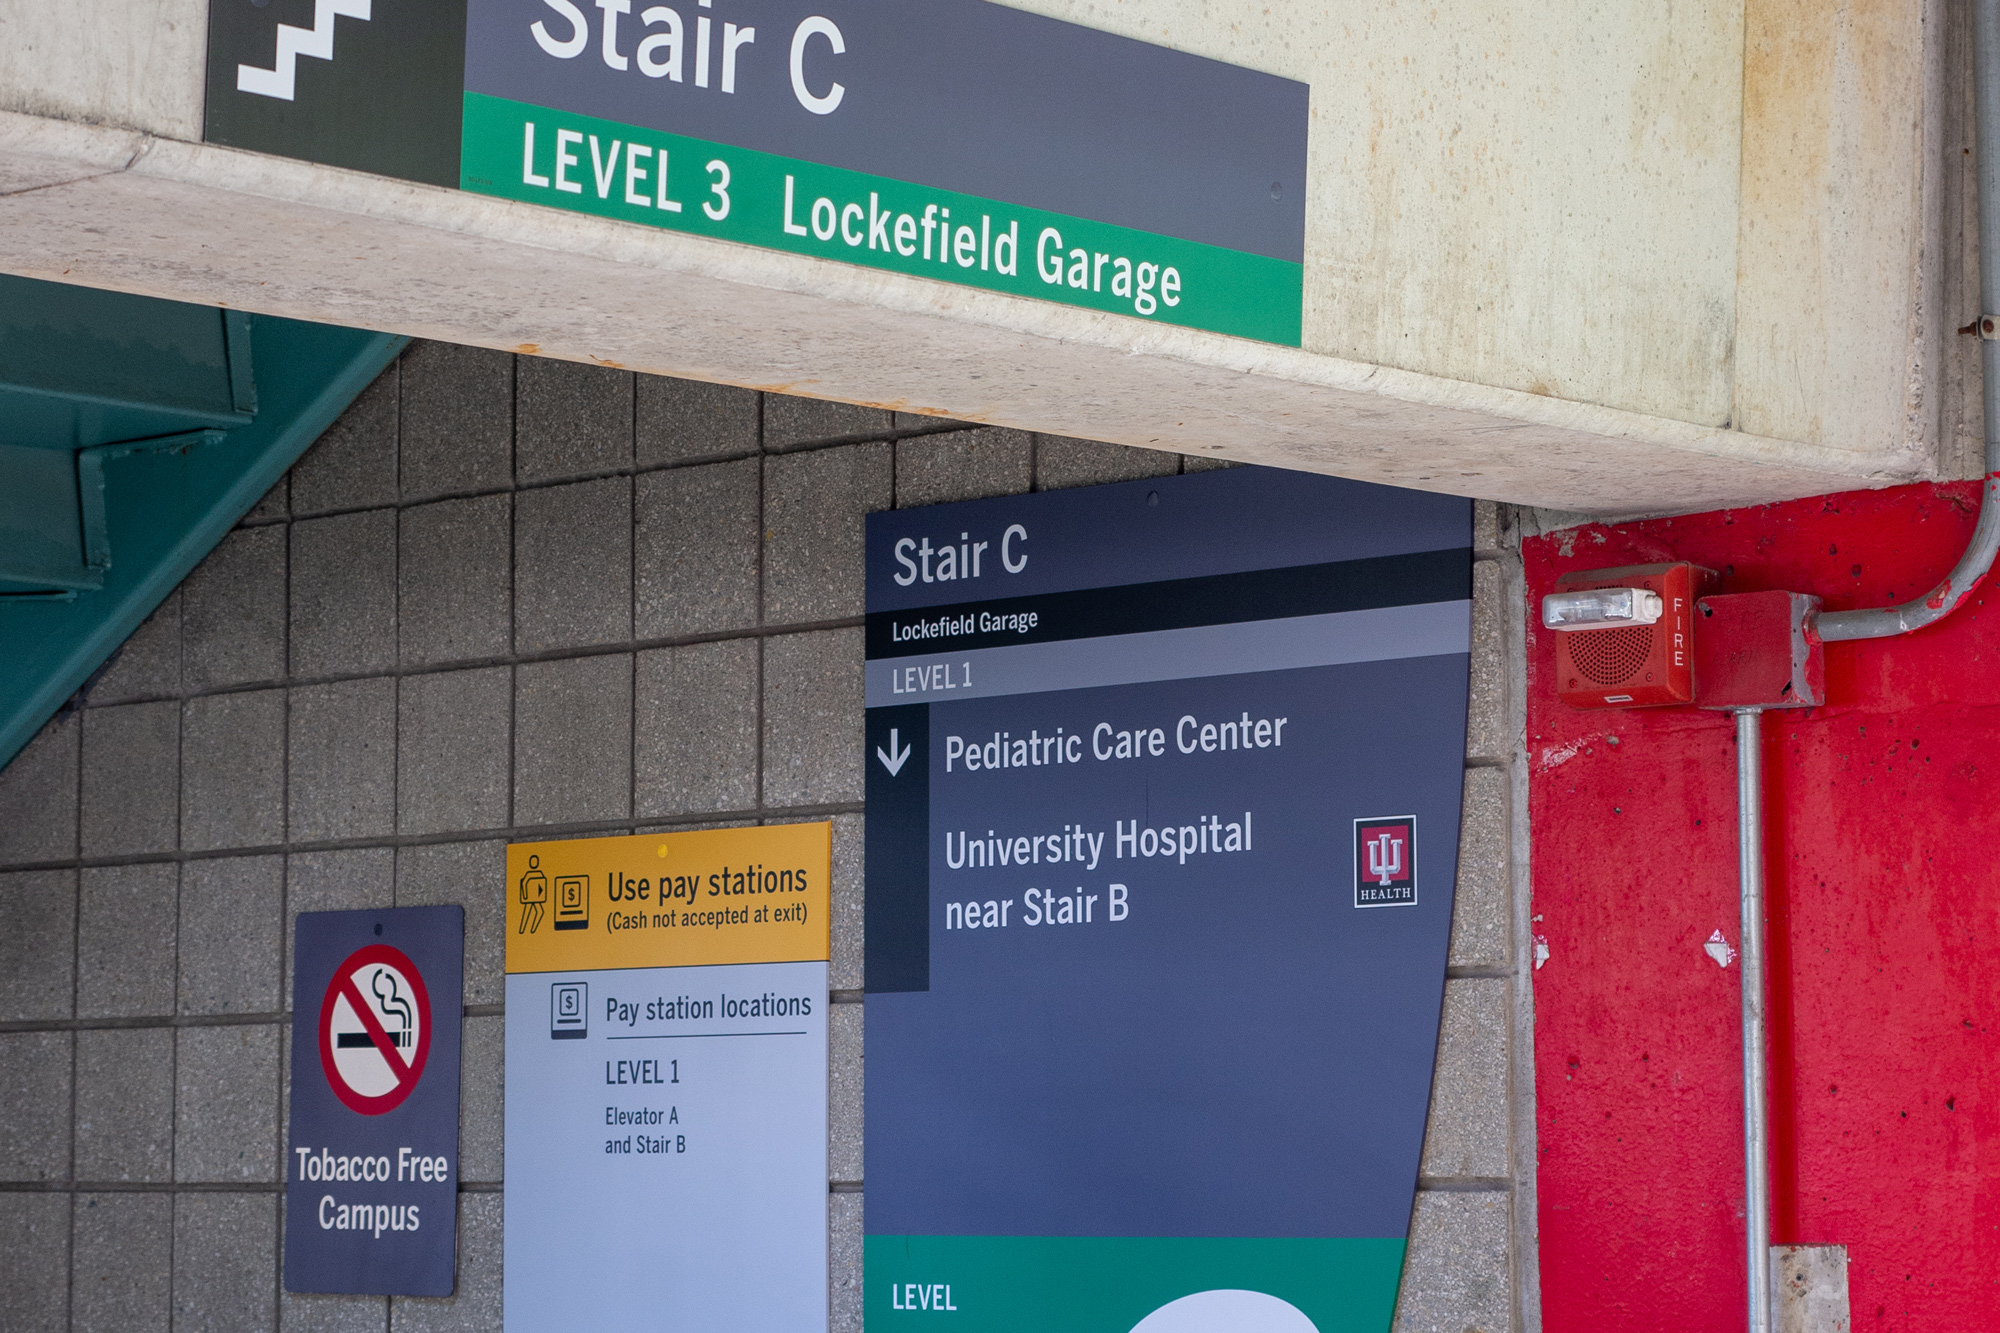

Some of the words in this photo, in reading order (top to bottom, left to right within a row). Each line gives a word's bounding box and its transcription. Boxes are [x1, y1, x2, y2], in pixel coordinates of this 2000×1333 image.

[531, 0, 755, 93] Stair
[790, 16, 845, 114] C
[522, 122, 681, 213] LEVEL
[702, 159, 731, 221] 3
[782, 175, 1018, 276] Lockefield
[1037, 228, 1181, 315] Garage
[894, 532, 987, 586] Stair
[1001, 523, 1028, 574] C
[893, 613, 975, 642] Lockefield
[979, 611, 1038, 634] Garage
[1673, 597, 1684, 666] FIRE
[893, 663, 957, 694] LEVEL
[962, 661, 973, 688] 1
[947, 728, 1081, 772] Pediatric
[1092, 722, 1166, 761] Care
[1177, 712, 1287, 753] Center
[947, 825, 1104, 870] University
[1117, 812, 1251, 864] Hospital
[608, 871, 650, 902] Use
[659, 875, 701, 907] pay
[707, 863, 807, 897] stations
[1360, 887, 1411, 901] HEALTH
[606, 910, 648, 935] (Cash
[652, 910, 677, 930] not
[680, 906, 750, 931] accepted
[752, 906, 770, 925] at
[773, 902, 808, 926] exit)
[946, 899, 1014, 930] near
[1023, 886, 1098, 927] Stair
[1109, 883, 1129, 922] B
[606, 997, 641, 1027] Pay
[646, 995, 714, 1021] station
[721, 992, 812, 1018] locations
[606, 1059, 664, 1085] LEVEL
[670, 1059, 680, 1084] 1
[605, 1106, 665, 1126] Elevator
[668, 1105, 679, 1125] A
[605, 1135, 631, 1154] and
[636, 1134, 672, 1154] Stair
[676, 1134, 686, 1154] B
[295, 1147, 391, 1182] Tobacco
[397, 1147, 448, 1183] Free
[319, 1195, 419, 1238] Campus
[892, 1283, 958, 1311] LEVEL
